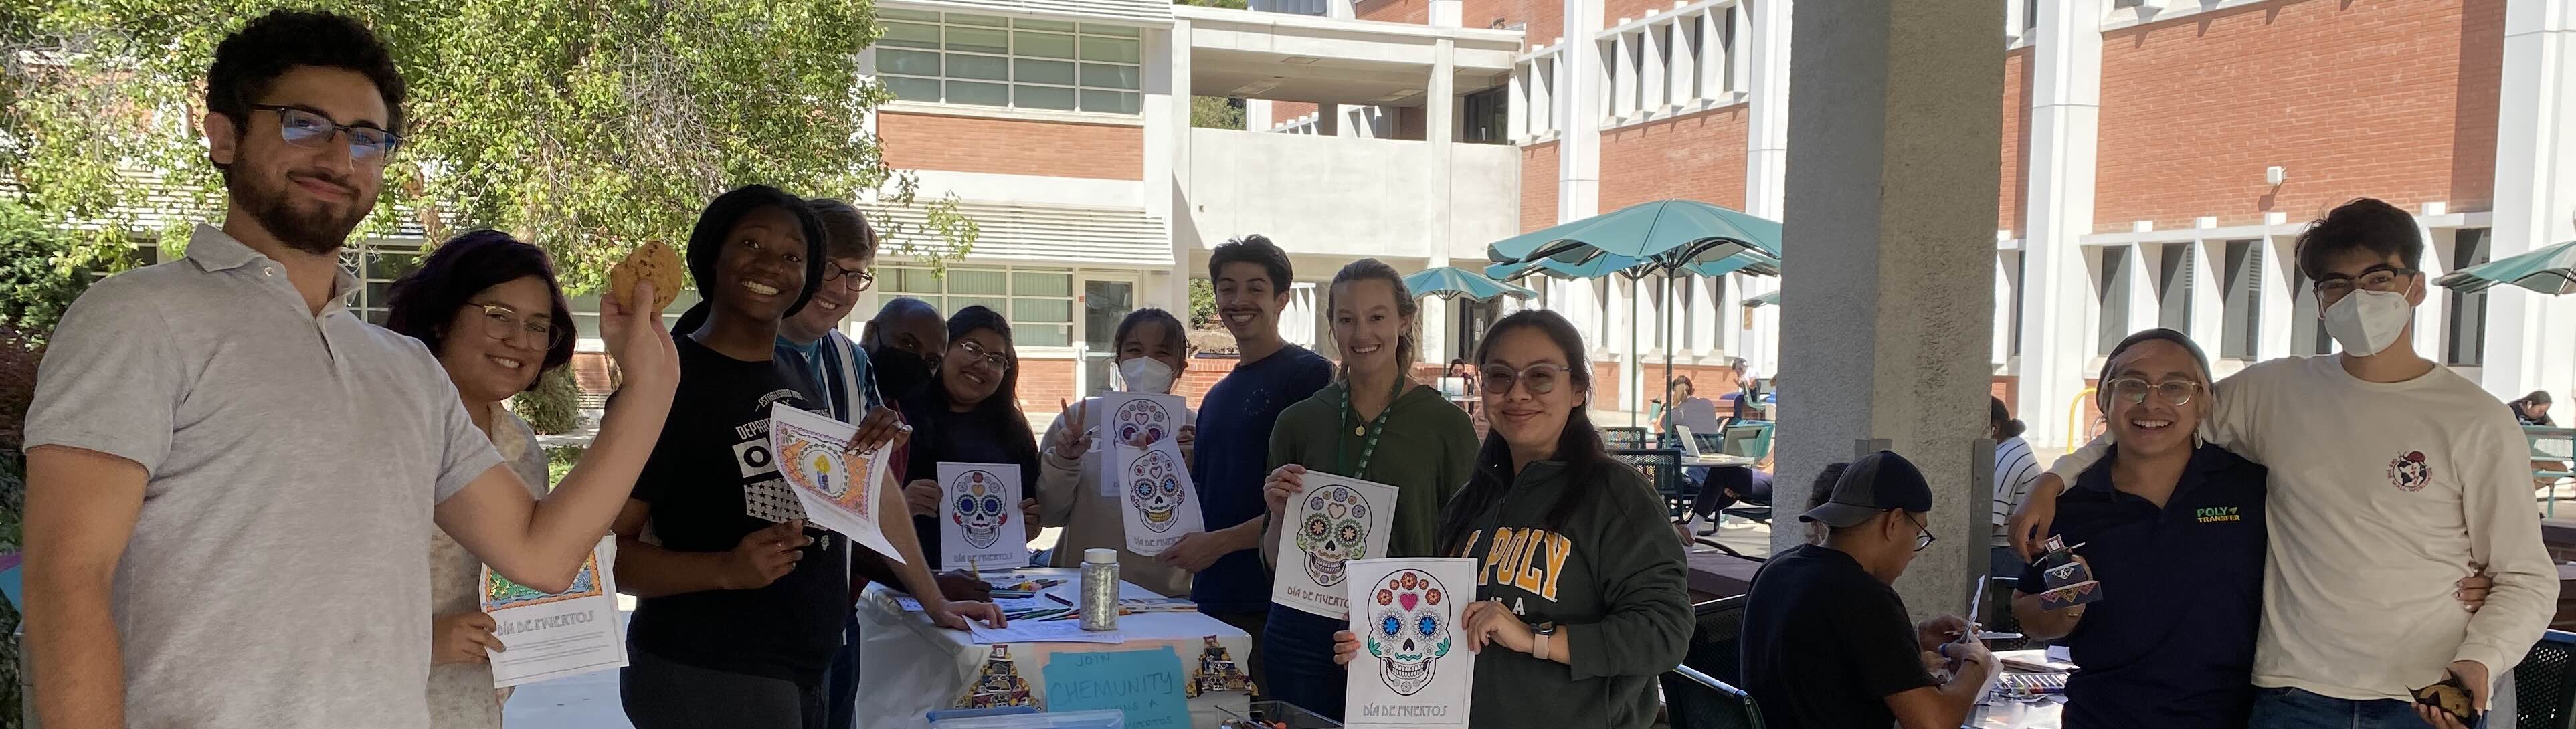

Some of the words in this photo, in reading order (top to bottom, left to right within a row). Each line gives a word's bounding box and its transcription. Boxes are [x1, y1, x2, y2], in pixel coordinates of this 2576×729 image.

[736, 417, 771, 440] DEPART
[2197, 506, 2227, 518] POLY
[2197, 514, 2240, 523] TRANSFER
[1477, 526, 1572, 602] POLY
[1287, 585, 1301, 598] DÍA
[1302, 590, 1313, 601] DE
[1315, 593, 1350, 609] MUERTO
[517, 619, 534, 633] DE
[535, 610, 595, 631] MUERTOS
[1075, 653, 1110, 666] JOIN
[1050, 671, 1173, 706] CHEMUNITY
[1149, 699, 1158, 710] A
[1363, 702, 1380, 717] DÍA
[1382, 704, 1396, 717] DE
[1397, 704, 1447, 717] MUERTOS
